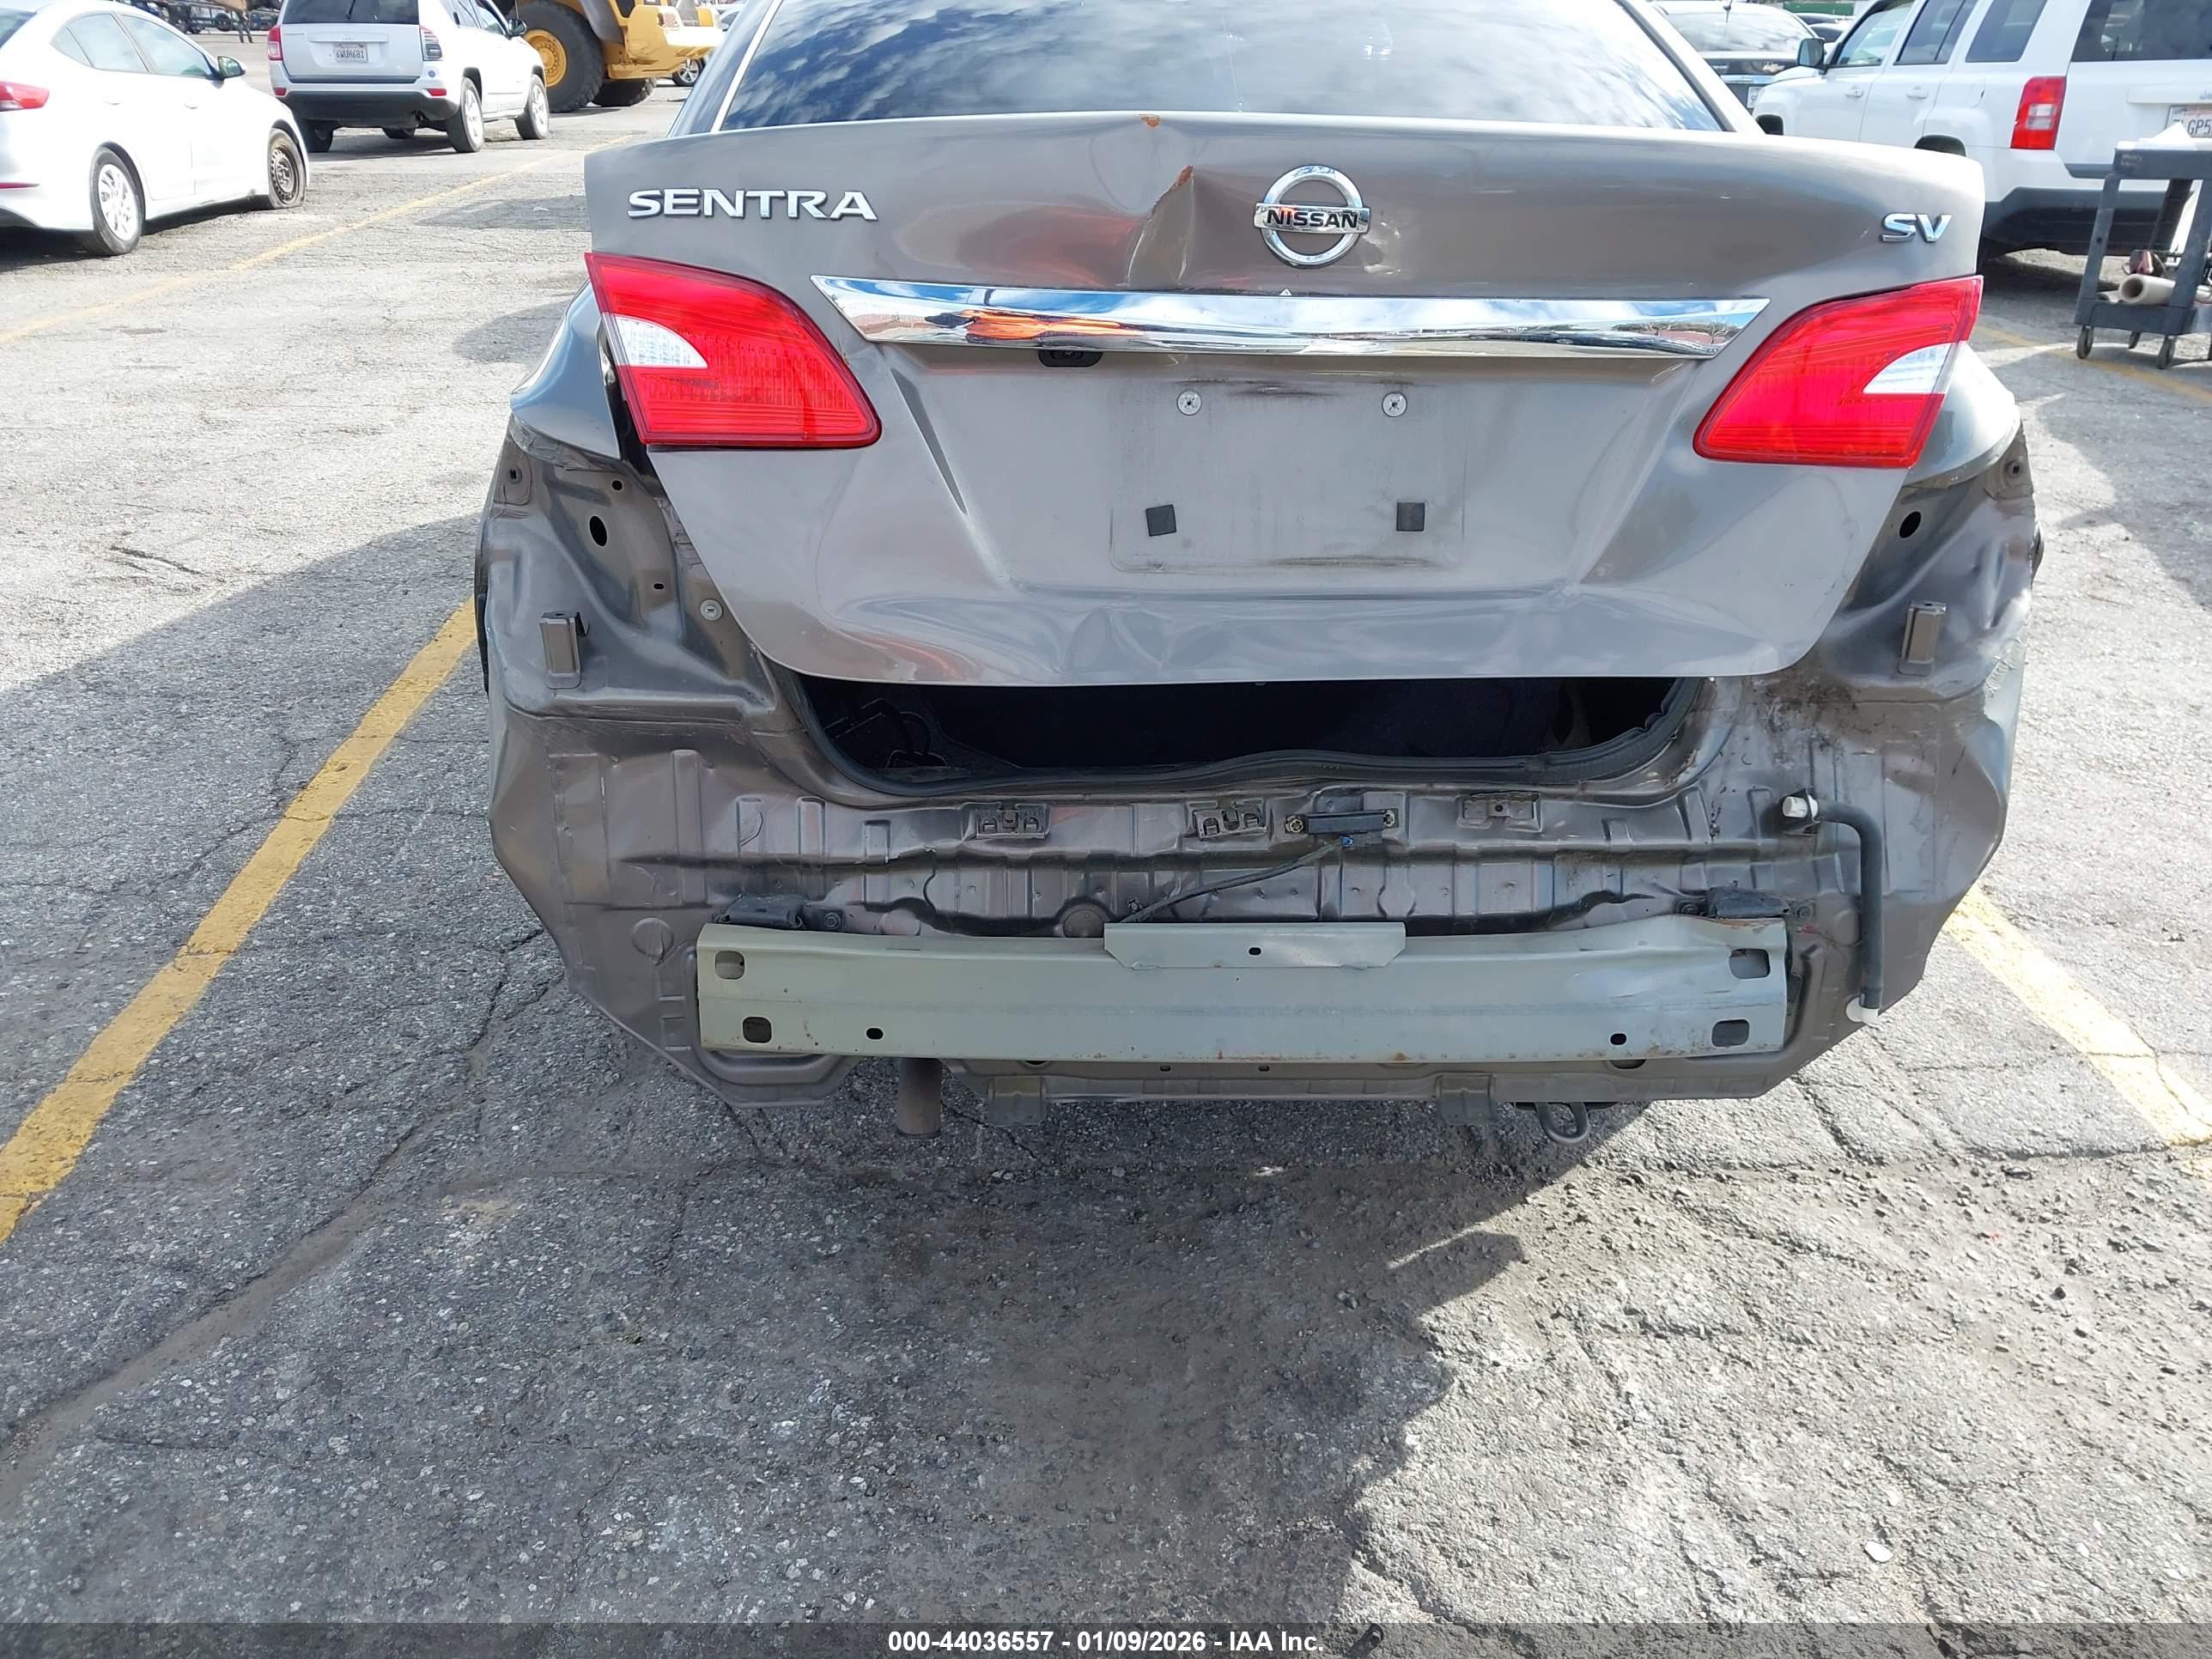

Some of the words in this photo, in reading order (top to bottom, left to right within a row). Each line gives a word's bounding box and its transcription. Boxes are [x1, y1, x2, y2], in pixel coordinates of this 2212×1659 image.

[627, 188, 878, 221] SENTRA
[1267, 210, 1358, 228] NISSAN
[1881, 213, 1952, 242] SV
